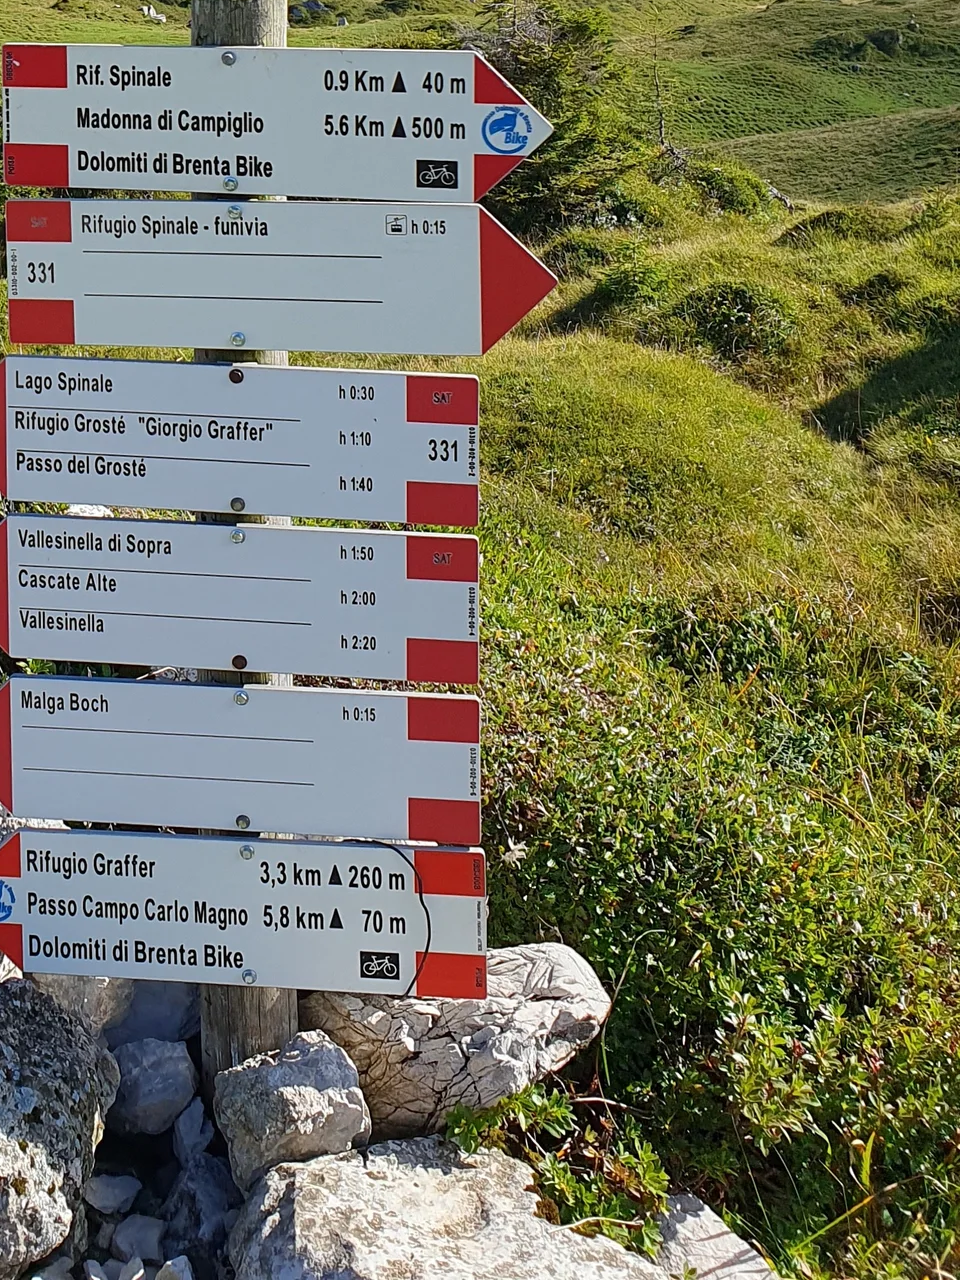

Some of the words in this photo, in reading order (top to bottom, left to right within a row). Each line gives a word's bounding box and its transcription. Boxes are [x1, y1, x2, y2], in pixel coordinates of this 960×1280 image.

[76, 64, 105, 86] Rif.
[109, 64, 172, 92] Spinale
[323, 69, 349, 92] 0.9
[354, 70, 385, 93] Km
[421, 71, 444, 94] 40
[450, 77, 466, 95] m
[76, 107, 153, 131] Madonna
[157, 109, 173, 131] di
[177, 109, 264, 139] Campiglio
[323, 114, 349, 137] 5.6
[354, 114, 385, 138] Km
[411, 116, 444, 139] 500
[449, 123, 466, 140] m
[505, 132, 528, 144] Bike
[77, 150, 148, 174] Dolomiti
[152, 152, 168, 174] di
[172, 152, 231, 176] Brenta
[235, 155, 273, 178] Bike
[81, 214, 137, 239] Rifugio
[141, 214, 199, 239] Spinale
[215, 216, 268, 236] funivia
[411, 219, 419, 235] h
[422, 219, 446, 235] 0:15
[27, 261, 55, 284] 331
[15, 370, 53, 395] Lago
[57, 371, 113, 396] Spinale
[338, 384, 346, 400] h
[349, 385, 375, 401] 0:30
[433, 393, 452, 404] SAT
[15, 411, 68, 435] Rifugio
[74, 413, 126, 435] Grosté
[139, 417, 202, 442] "Giorgio
[208, 421, 273, 441] Graffer"
[339, 430, 347, 446] h
[350, 431, 372, 447] 1:10
[428, 438, 458, 463] 331
[17, 452, 62, 472] Passo
[68, 455, 89, 474] del
[95, 456, 146, 477] Grosté
[339, 475, 347, 491] h
[350, 476, 373, 492] 1:40
[17, 528, 103, 552] Vallesinella
[108, 533, 121, 553] di
[126, 534, 172, 559] Sopra
[340, 544, 347, 560] h
[351, 545, 374, 561] 1:50
[433, 553, 452, 564] SAT
[19, 570, 80, 590] Cascate
[85, 572, 117, 593] Alte
[340, 589, 348, 605] h
[351, 590, 376, 606] 2:00
[20, 611, 104, 632] Vallesinella
[340, 634, 348, 649] h
[351, 635, 377, 651] 2:20
[21, 690, 65, 715] Malga
[69, 692, 109, 713] Boch
[342, 706, 350, 721] h
[353, 706, 376, 722] 0:15
[26, 849, 88, 880] Rifugio
[93, 852, 156, 879] Graffer
[259, 861, 287, 889] 3,3
[293, 862, 322, 887] km
[348, 865, 382, 890] 260
[388, 872, 406, 891] m
[27, 891, 78, 917] Passo
[82, 894, 140, 925] Campo
[144, 898, 189, 923] Carlo
[194, 900, 249, 931] Magno
[263, 904, 290, 932] 5,8
[296, 905, 324, 930] km
[361, 909, 383, 934] 70
[389, 916, 406, 935] m
[28, 934, 107, 961] Dolomiti
[112, 939, 129, 963] di
[134, 940, 198, 967] Brenta
[203, 944, 244, 969] Bike
